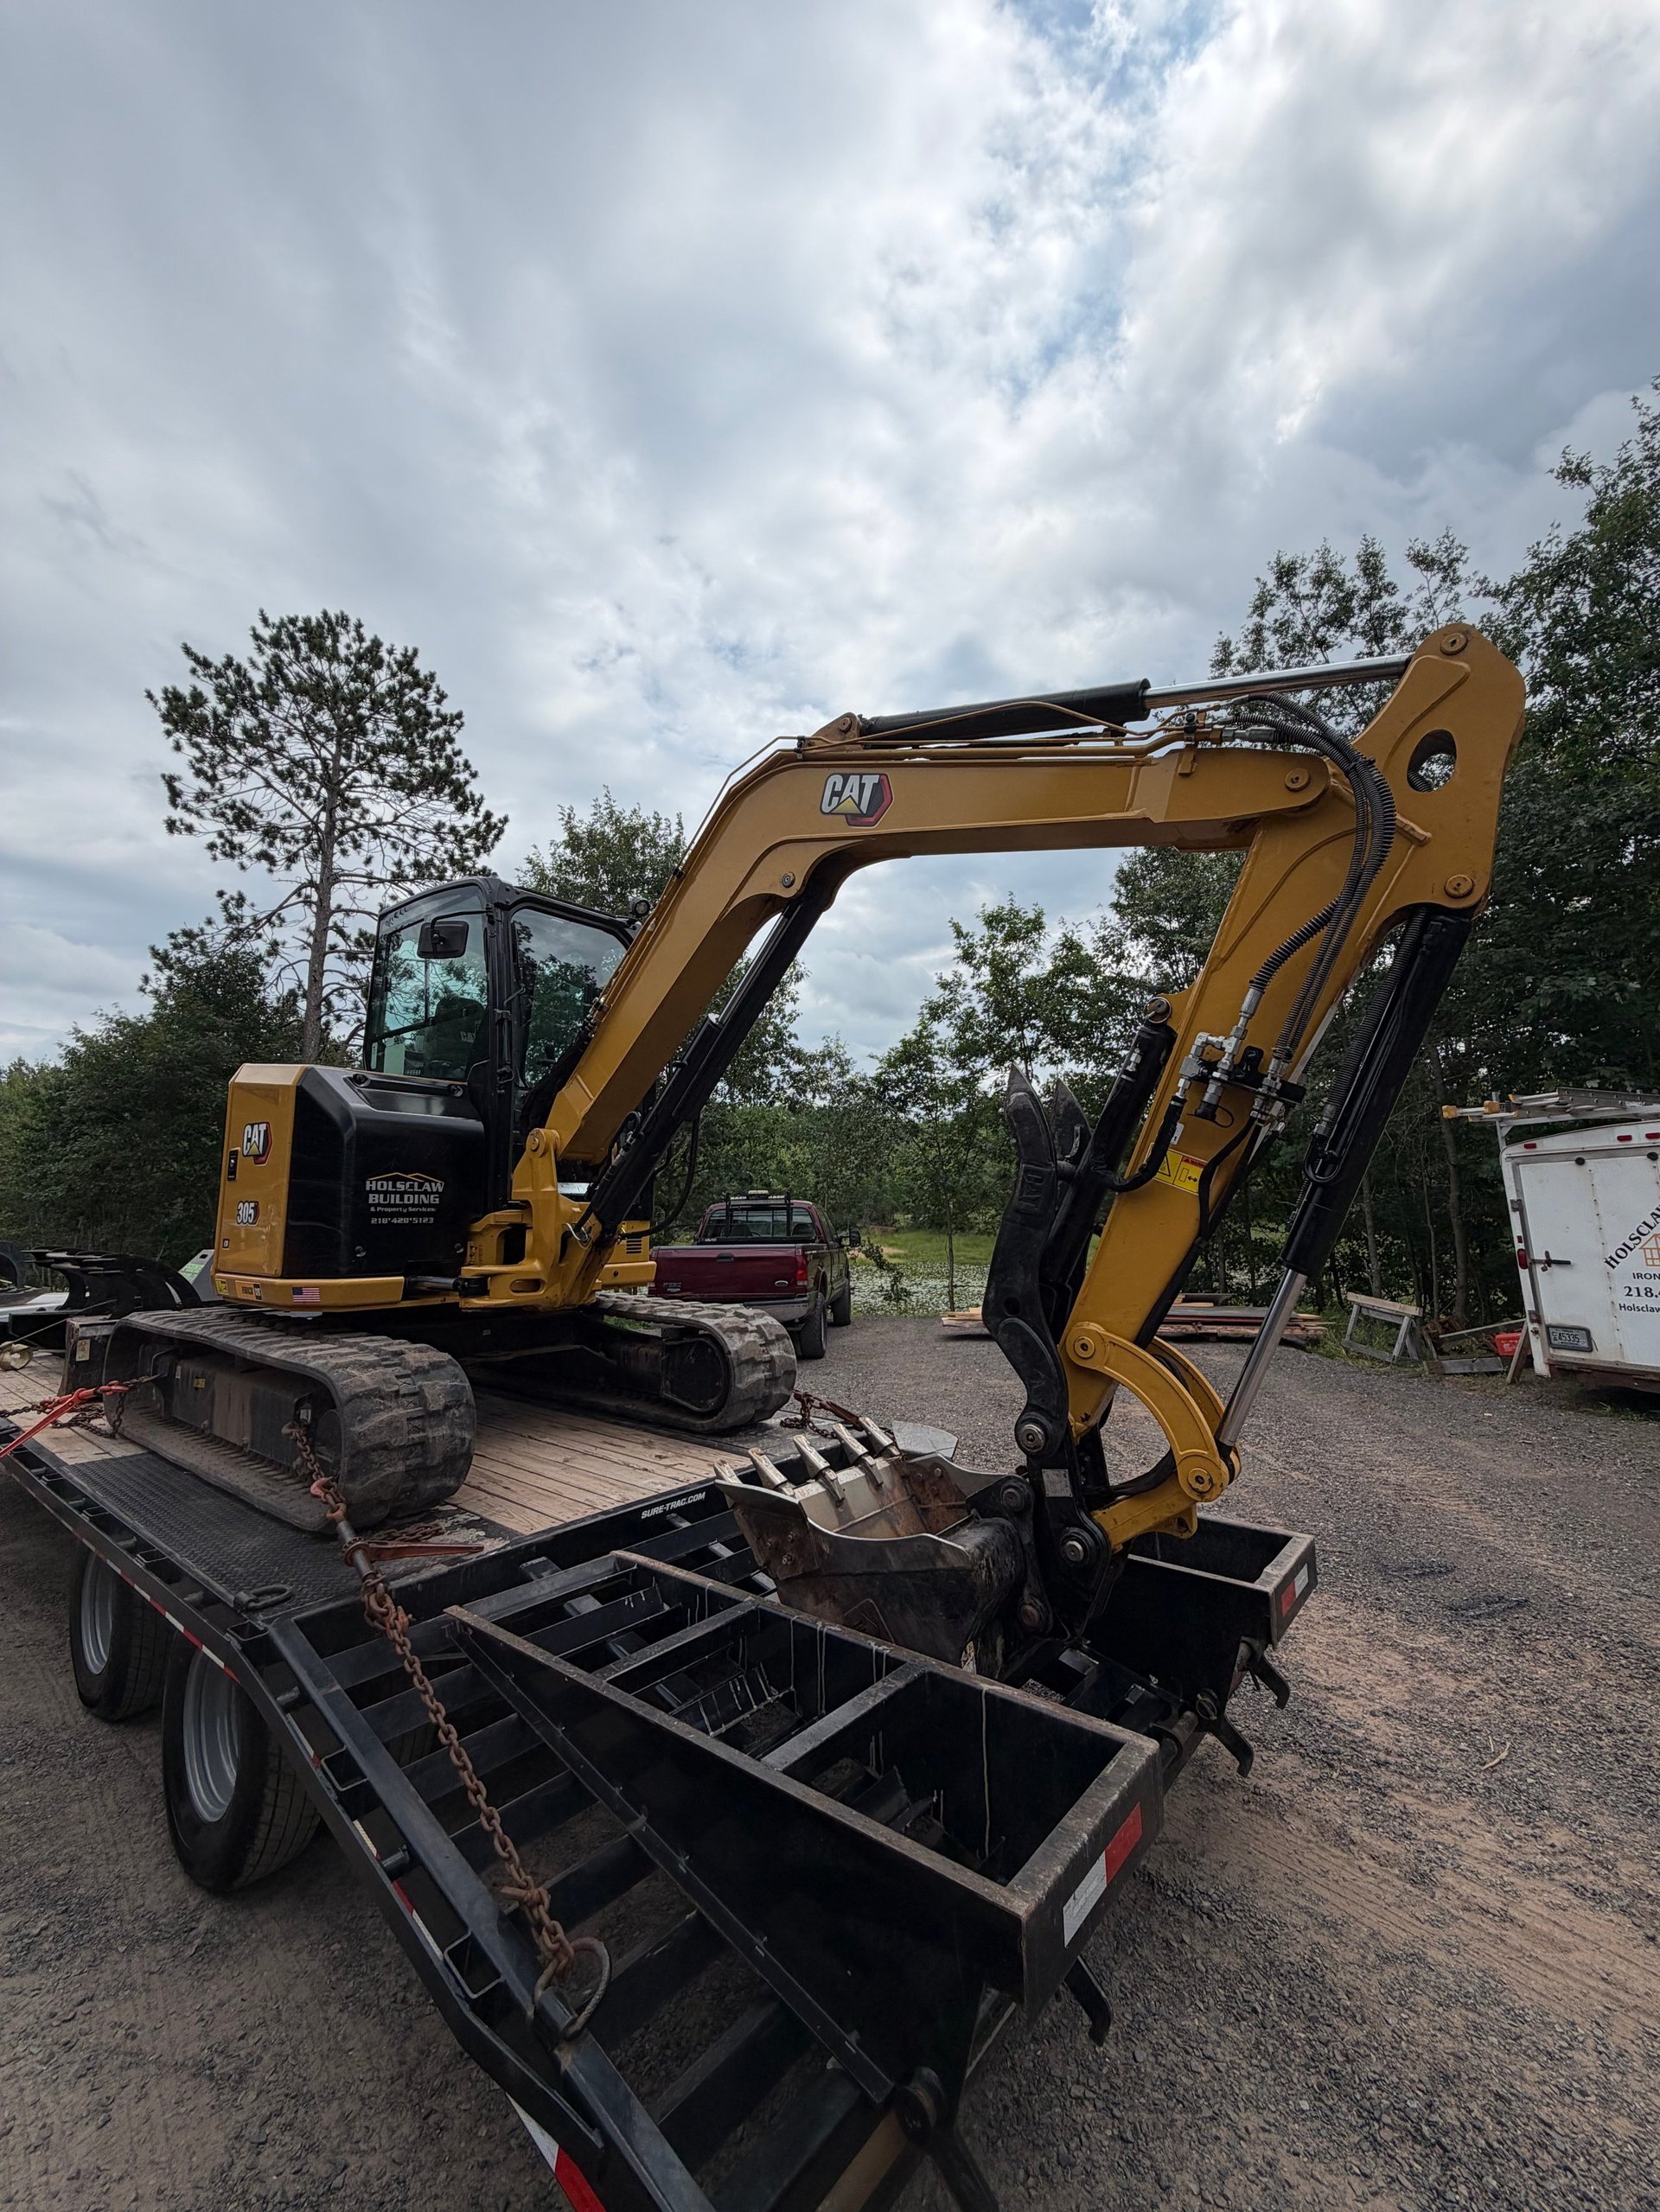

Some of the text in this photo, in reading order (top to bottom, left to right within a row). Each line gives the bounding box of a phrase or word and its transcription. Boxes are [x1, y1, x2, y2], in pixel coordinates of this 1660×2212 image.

[820, 774, 880, 814] CAT
[243, 1123, 267, 1156] CAT
[365, 1180, 444, 1192] HOLSCLAW
[367, 1193, 440, 1204] BUILDING
[237, 1202, 255, 1224] 305
[1624, 1285, 1660, 1298] 218.
[641, 1491, 706, 1520] SURE-TRAC.COM
